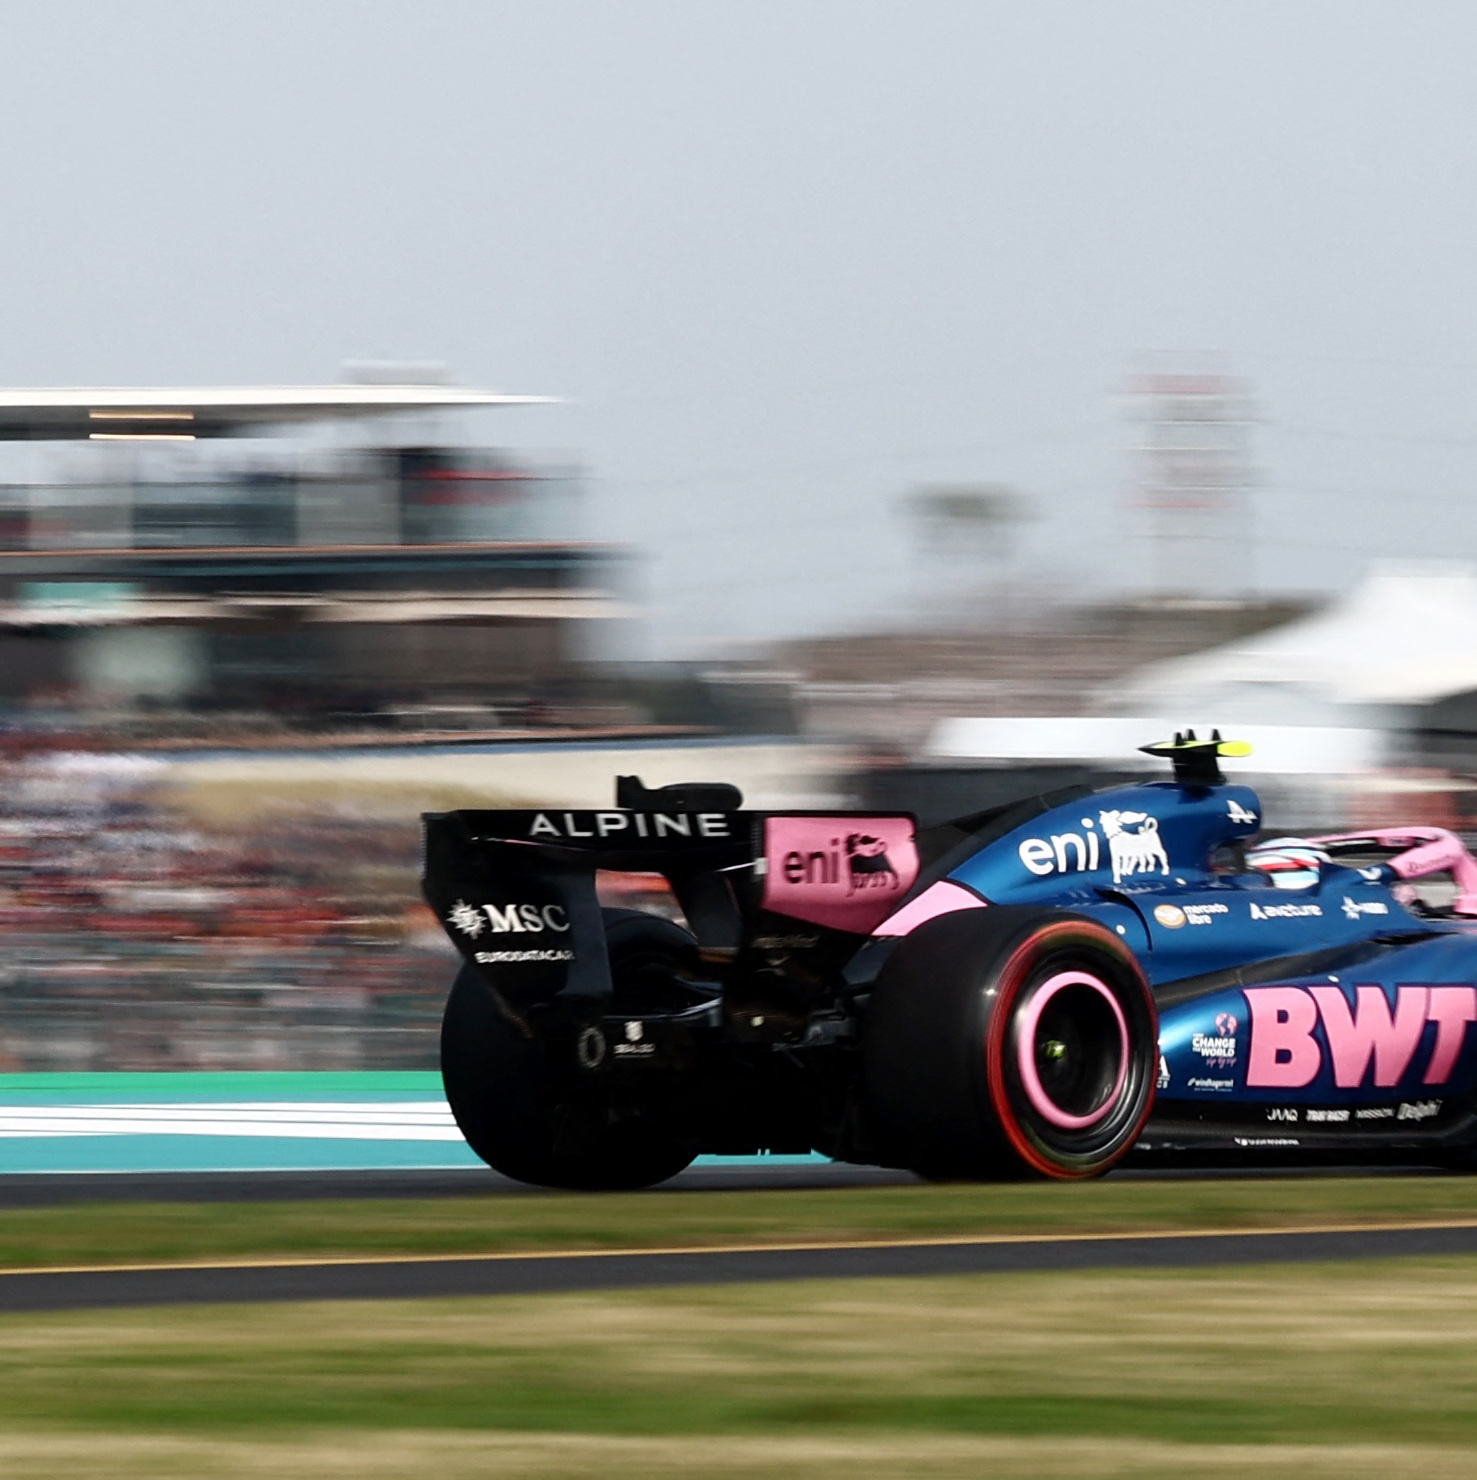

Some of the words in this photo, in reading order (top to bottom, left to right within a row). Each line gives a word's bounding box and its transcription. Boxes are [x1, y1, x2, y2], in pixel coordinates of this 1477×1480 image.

[529, 813, 731, 838] ALPINE
[1018, 817, 1099, 876] eni
[783, 837, 840, 884] eni
[481, 903, 571, 933] MSC
[1192, 1037, 1236, 1049] CHANGE
[1201, 1047, 1235, 1058] WORLD
